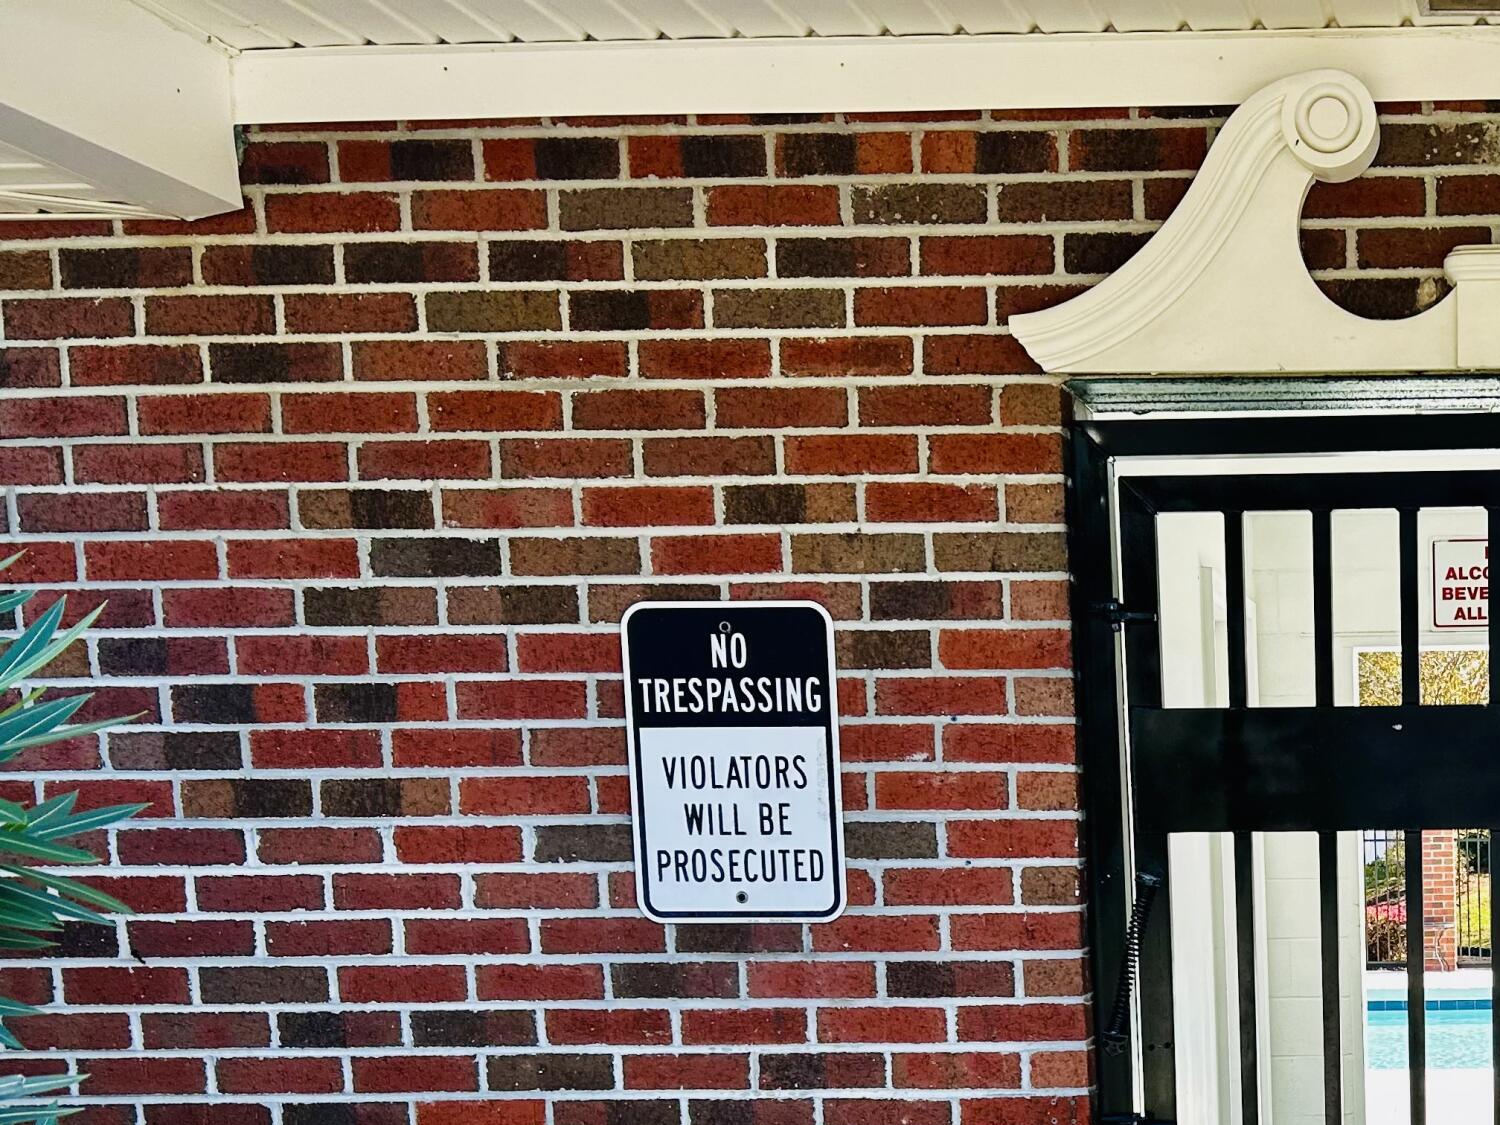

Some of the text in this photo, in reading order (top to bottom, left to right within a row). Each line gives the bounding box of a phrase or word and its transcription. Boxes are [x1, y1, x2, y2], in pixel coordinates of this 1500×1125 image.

[710, 632, 747, 669] NO
[638, 676, 821, 713] TRESPASSING
[661, 754, 808, 790] VIOLATORS
[684, 802, 792, 836] WILL BE
[656, 848, 824, 883] PROSECUTED
